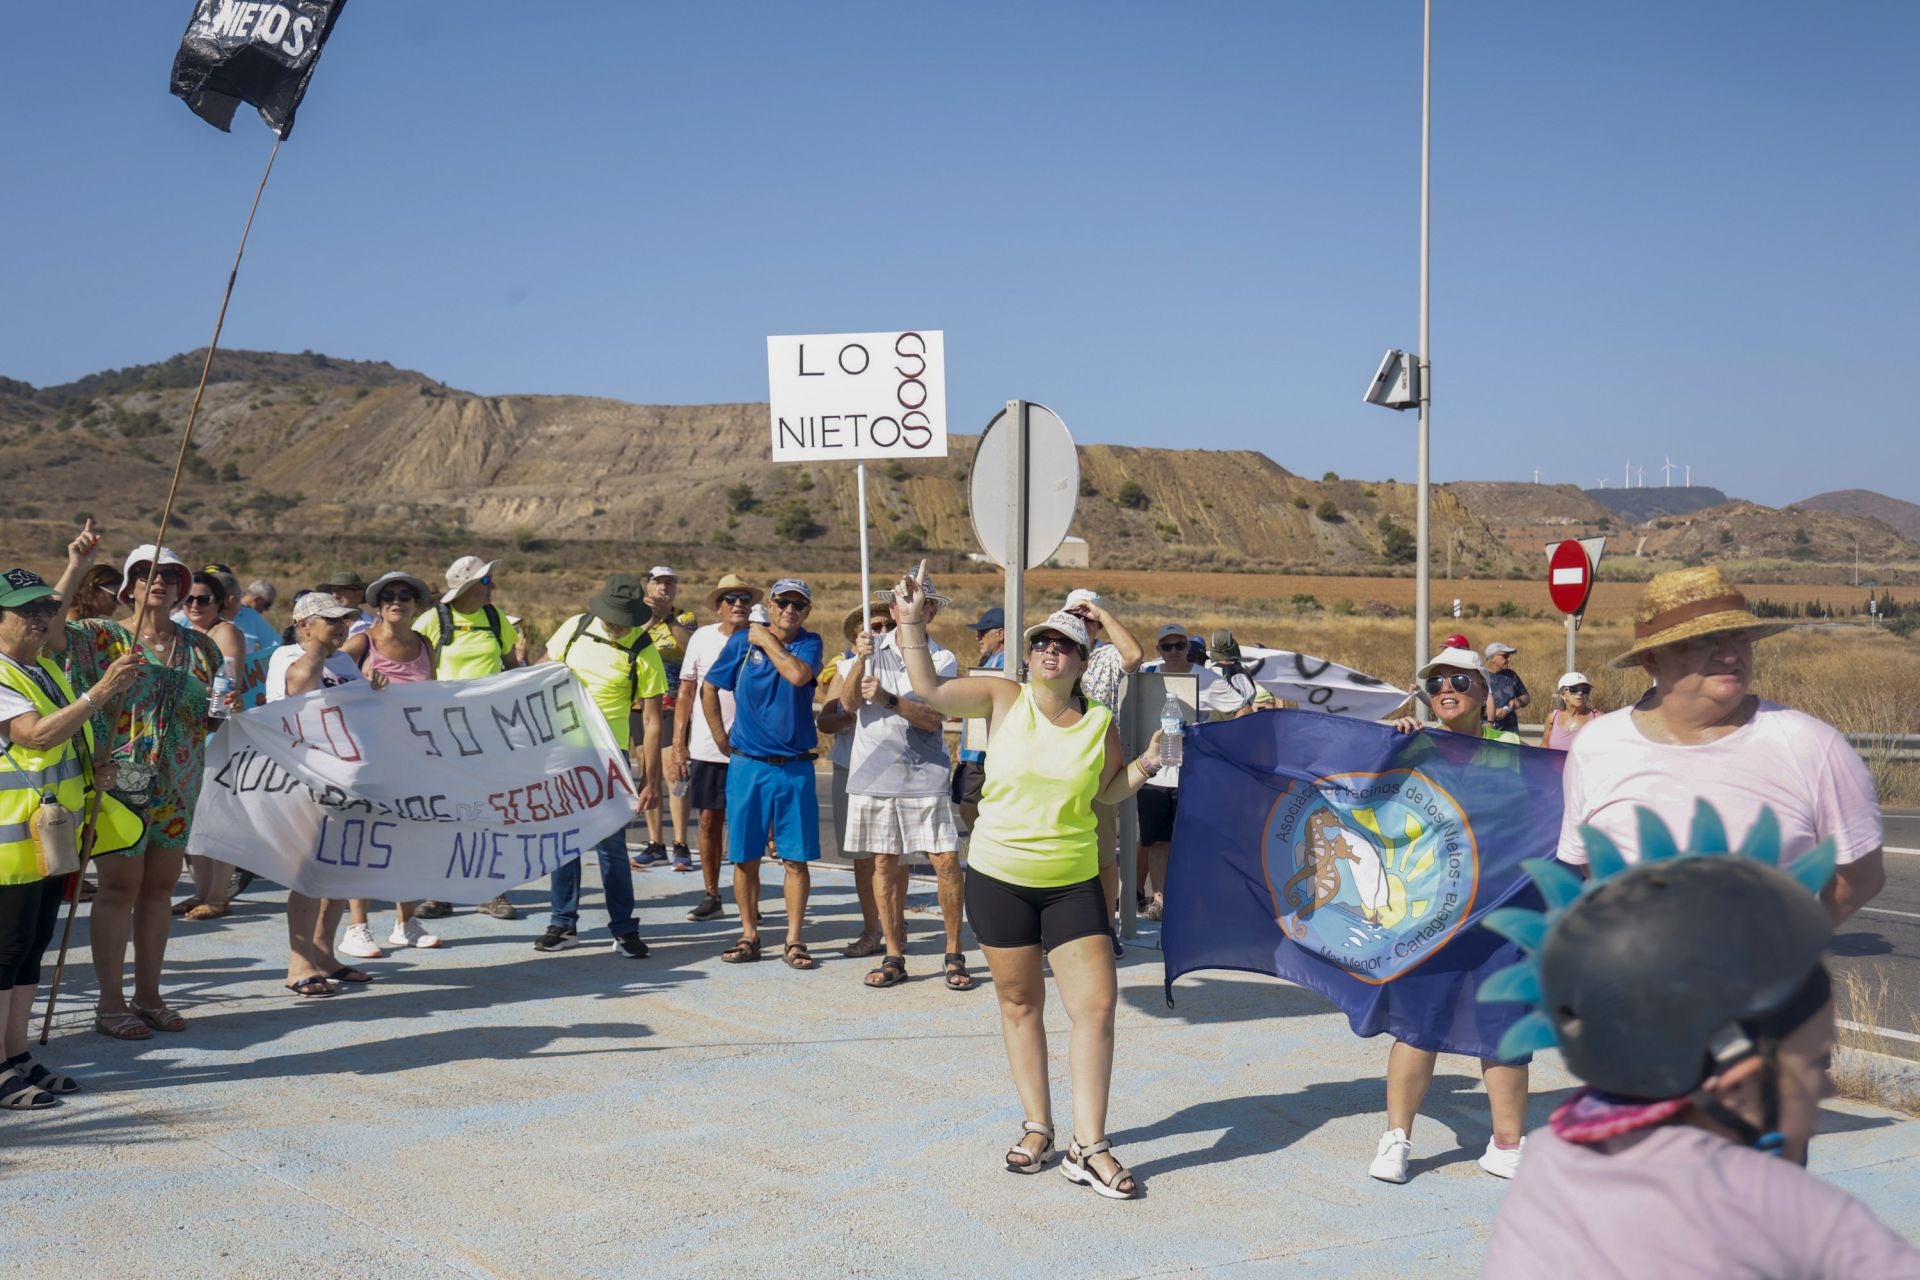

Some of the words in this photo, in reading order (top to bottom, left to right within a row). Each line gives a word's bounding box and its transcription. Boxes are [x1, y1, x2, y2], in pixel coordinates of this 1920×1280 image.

[798, 332, 926, 379] LOS
[779, 411, 933, 450] NIETOS
[488, 757, 634, 825] SEGUNDA
[1405, 786, 1424, 804] de
[1423, 798, 1446, 824] los
[316, 814, 398, 869] LOS
[446, 827, 580, 879] NIETOS
[1394, 892, 1458, 959] Cartagena
